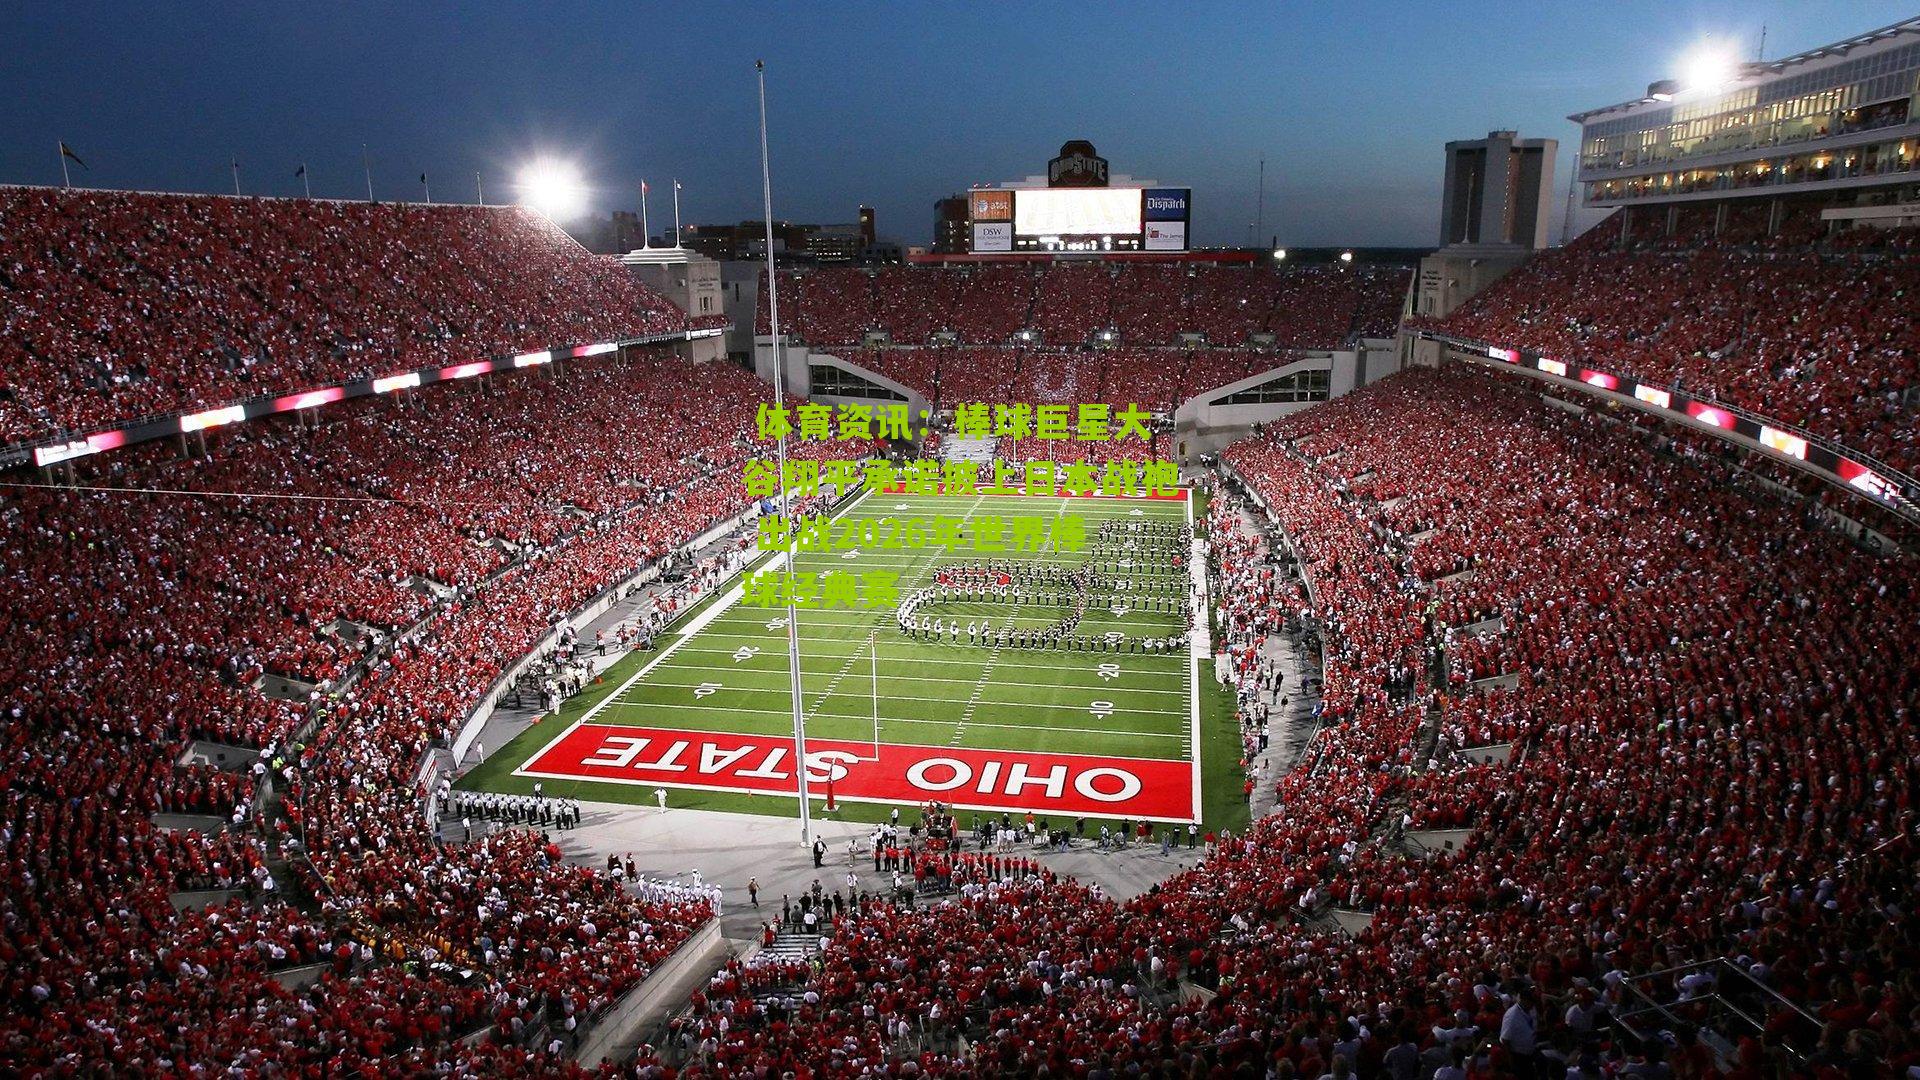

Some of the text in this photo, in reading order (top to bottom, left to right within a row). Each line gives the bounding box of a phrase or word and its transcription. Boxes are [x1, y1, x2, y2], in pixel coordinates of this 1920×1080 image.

[1147, 197, 1185, 210] Dispatch
[983, 228, 1002, 236] DSW
[732, 646, 761, 659] 20
[1097, 663, 1121, 678] 20
[694, 682, 723, 696] 10
[1089, 701, 1114, 715] 10
[580, 736, 1142, 802] OHIO STATE
